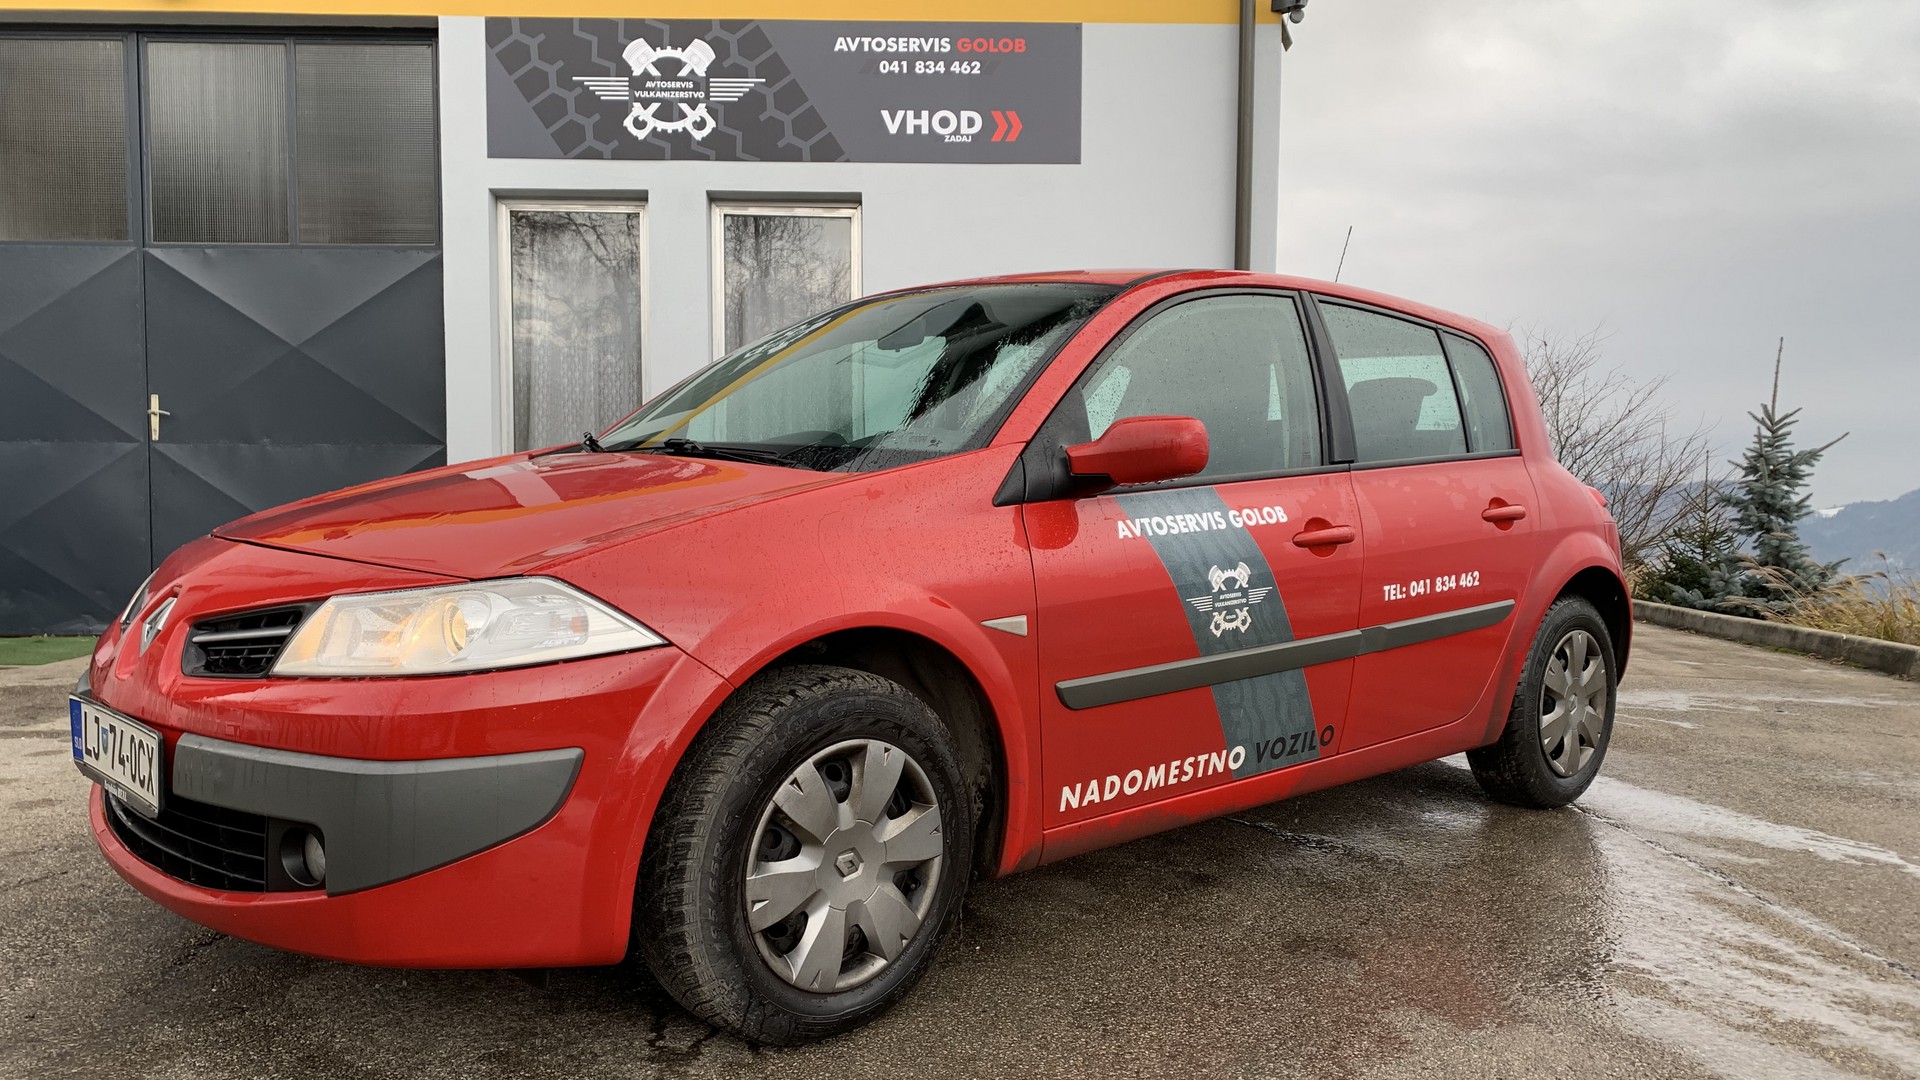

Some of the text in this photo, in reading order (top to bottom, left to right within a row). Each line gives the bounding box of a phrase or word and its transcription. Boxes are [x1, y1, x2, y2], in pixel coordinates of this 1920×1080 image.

[833, 36, 1027, 53] AVTOSERVIS GOLOB
[879, 60, 981, 75] 041 834 462
[634, 90, 706, 99] VULKANIZERSTVO
[645, 80, 694, 89] AVTOSERVIS
[880, 109, 983, 135] VHOD
[944, 135, 972, 143] ZADAJ
[1117, 505, 1288, 539] AVTOSERVIS GOLOB
[1383, 570, 1480, 601] TEL: 041 834 462
[84, 710, 100, 761] LJ
[1059, 725, 1335, 812] NADOMESTNO VOZILO
